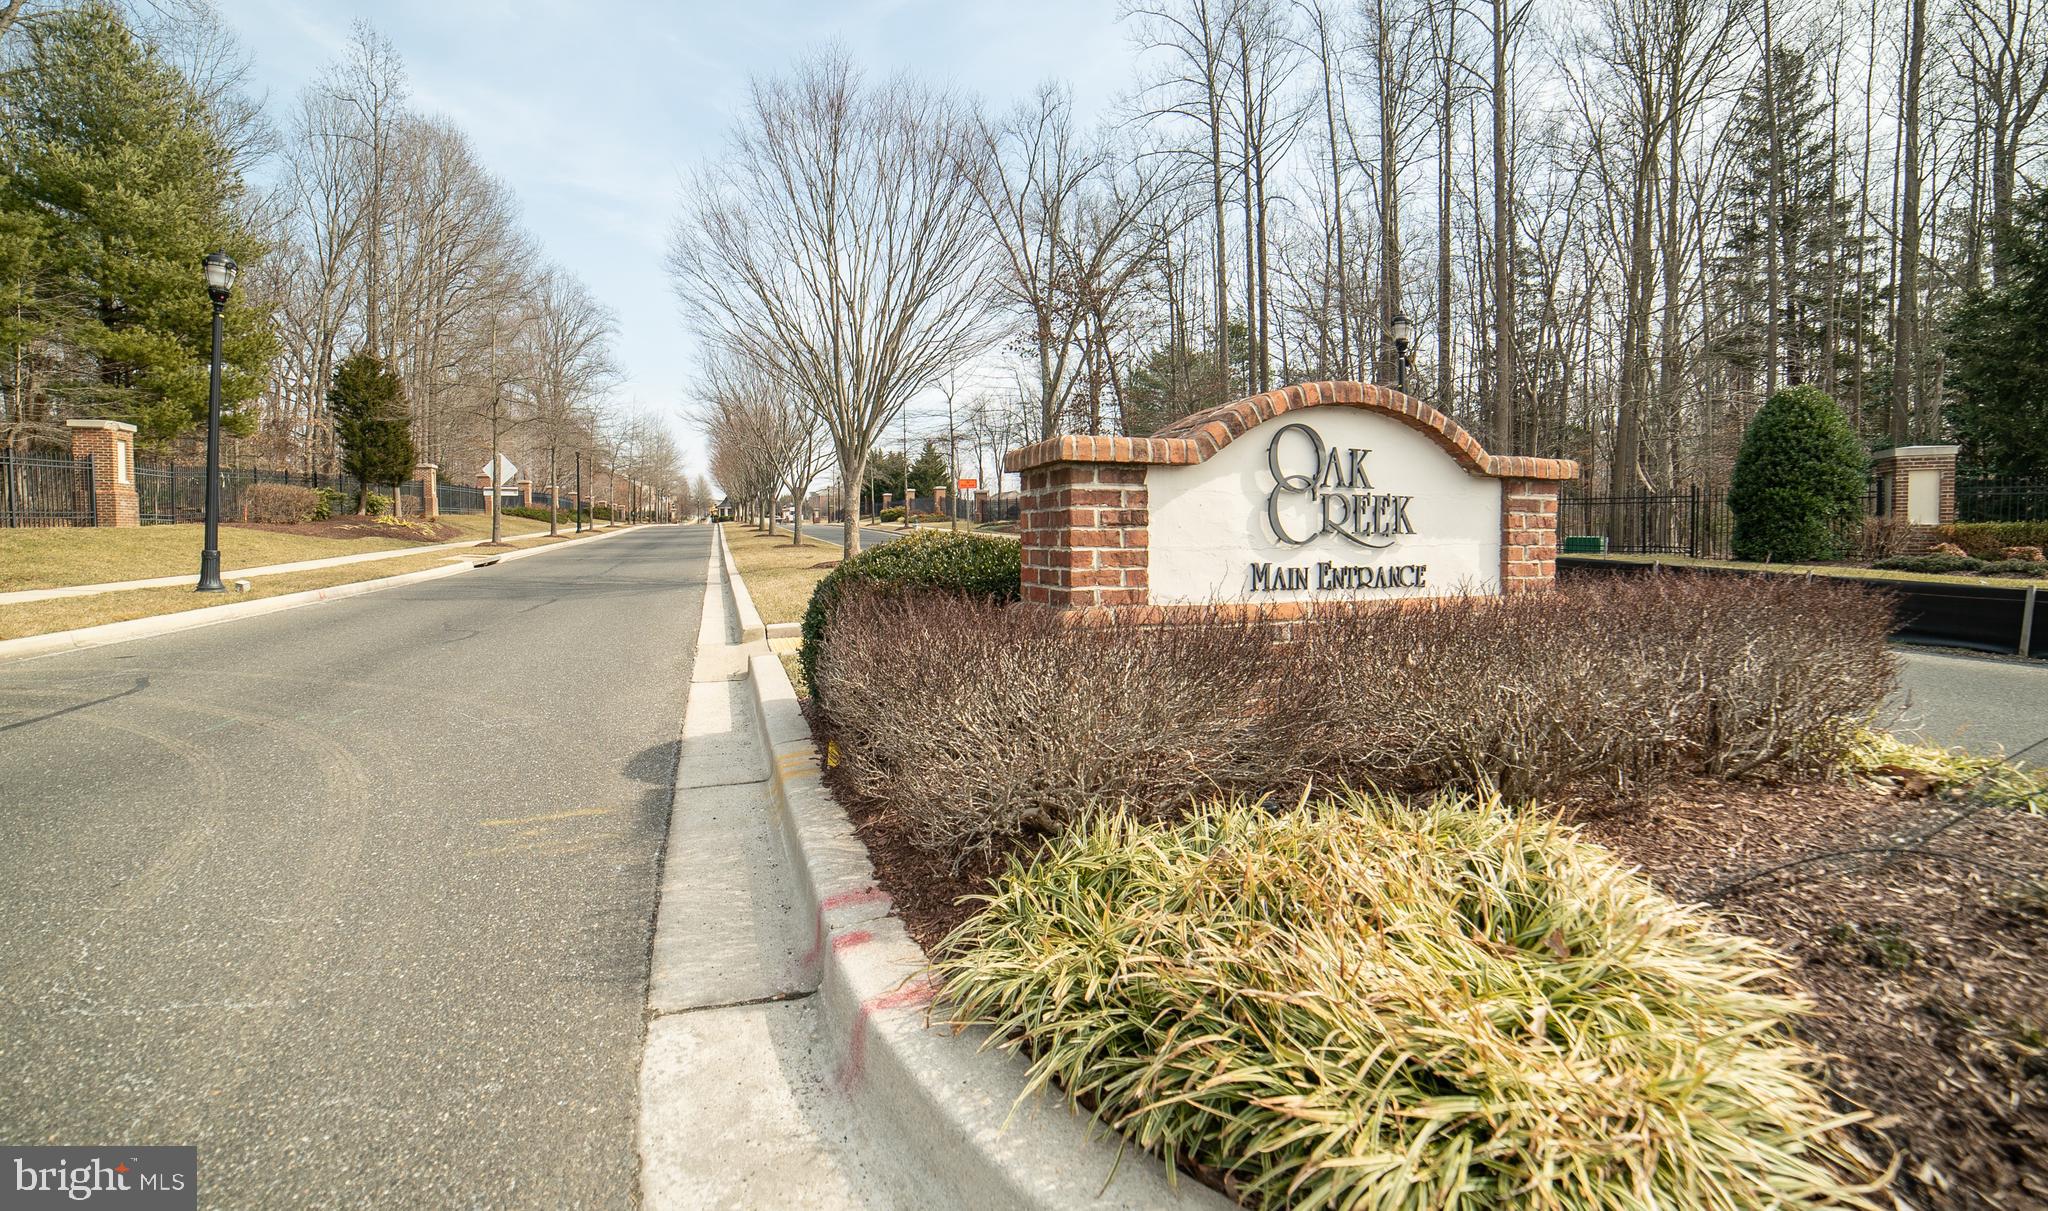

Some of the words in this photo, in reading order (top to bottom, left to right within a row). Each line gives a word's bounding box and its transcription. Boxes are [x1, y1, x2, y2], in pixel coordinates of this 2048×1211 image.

[1268, 423, 1374, 492] OAK
[1268, 475, 1416, 548] CREEK
[1251, 563, 1309, 592] MAIN
[1317, 560, 1427, 591] ENTRANCE
